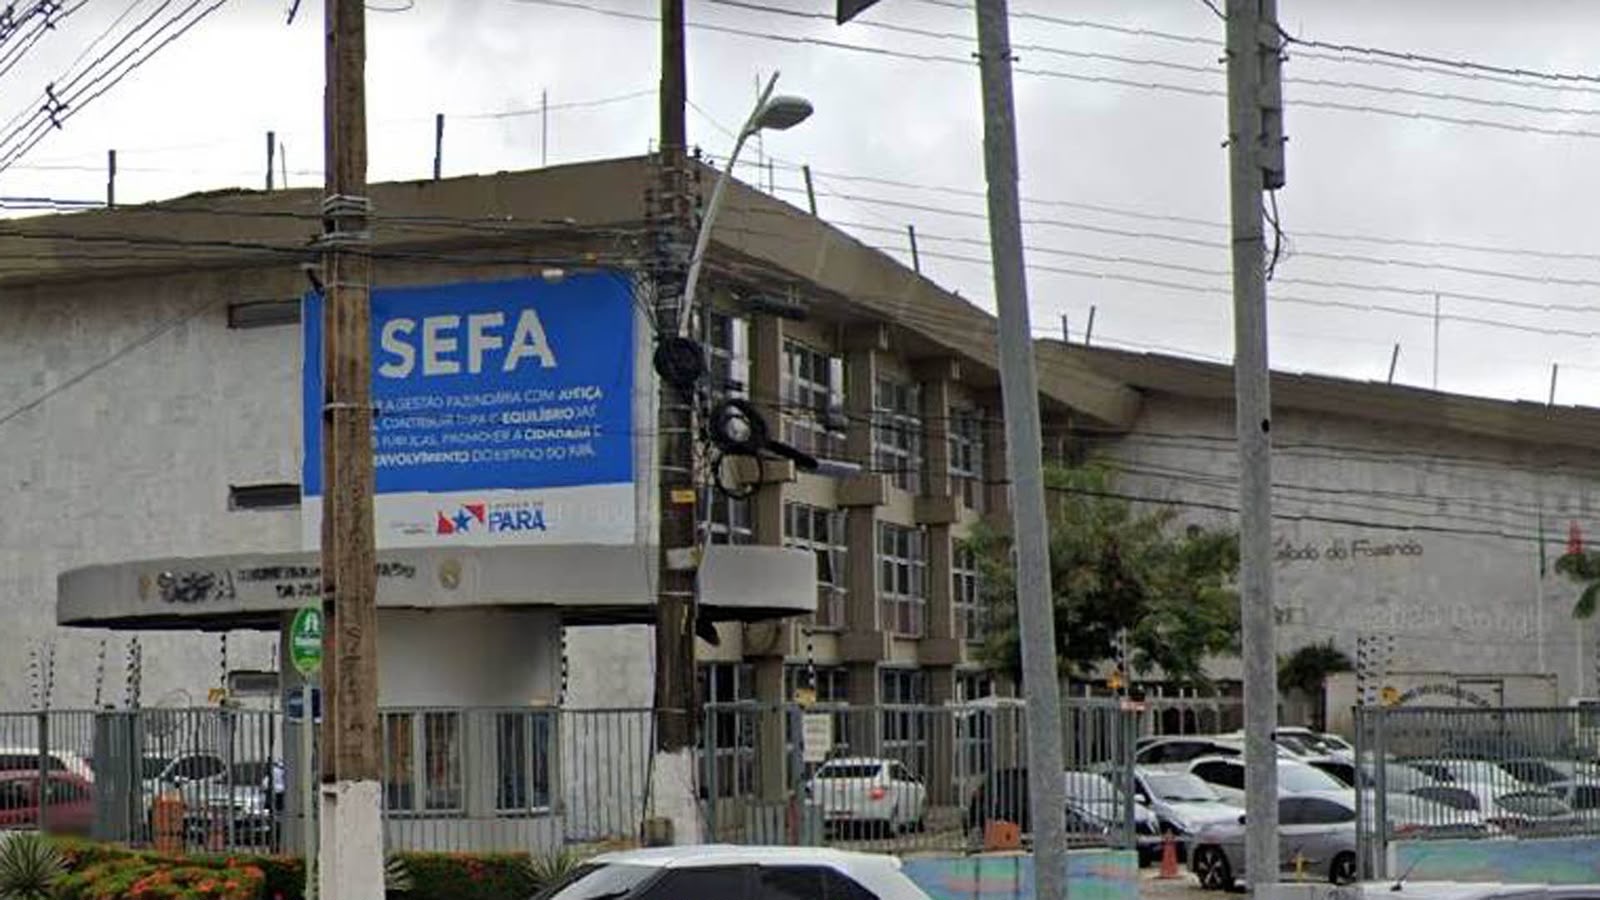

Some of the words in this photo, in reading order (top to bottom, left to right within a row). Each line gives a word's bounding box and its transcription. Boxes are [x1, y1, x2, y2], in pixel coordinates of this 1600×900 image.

[378, 308, 557, 379] SEFA
[558, 385, 604, 402] JUSTIÇA
[502, 404, 575, 425] EQUILÍBRIO
[524, 425, 592, 442] CIDADANIA
